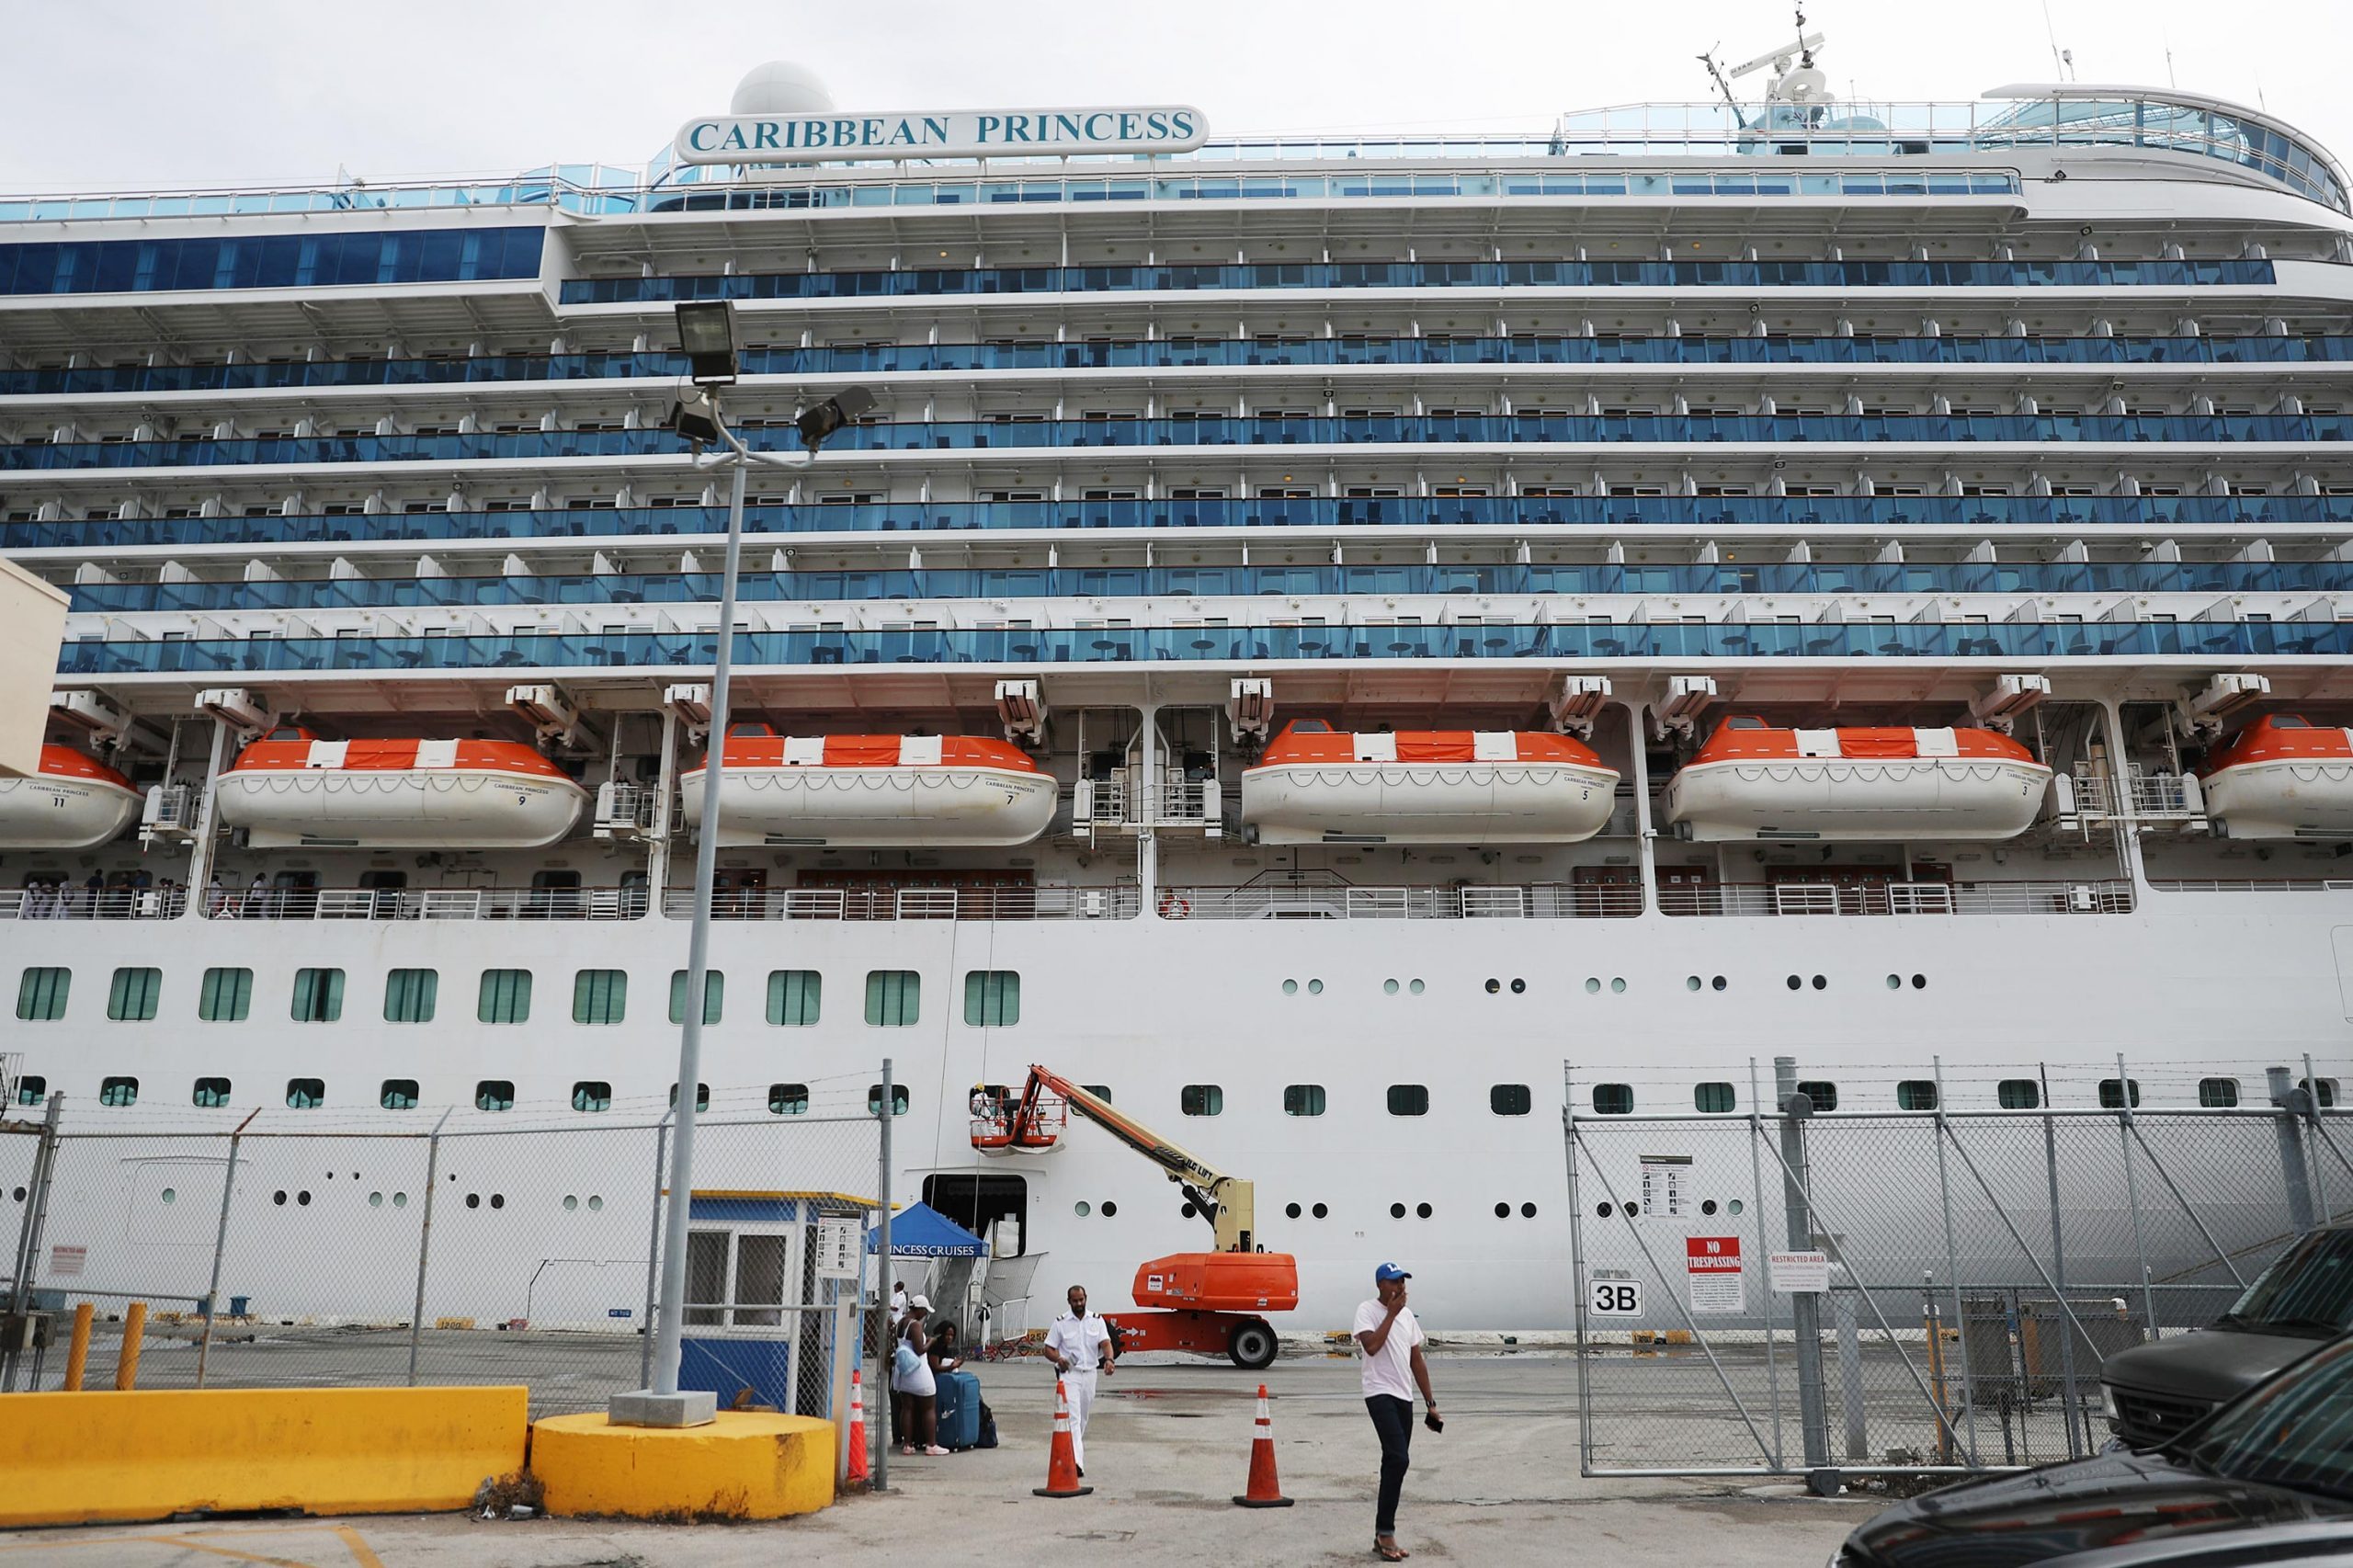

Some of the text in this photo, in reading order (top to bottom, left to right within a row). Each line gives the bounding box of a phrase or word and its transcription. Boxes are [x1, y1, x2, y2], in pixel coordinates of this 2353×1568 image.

[689, 111, 1194, 152] CARIBBEAN PRINCESS
[1582, 790, 1589, 801] 5
[2022, 785, 2028, 796] 3
[53, 797, 65, 808] 11
[518, 796, 526, 806] 9
[1006, 795, 1014, 805] 7
[1186, 1158, 1213, 1181] JLG LIFT
[874, 1244, 974, 1256] INCESS CRUISES
[1706, 1240, 1721, 1254] NO
[1688, 1256, 1741, 1268] TRESPASSING
[1771, 1255, 1809, 1263] RESTRICTED
[1596, 1285, 1636, 1311] 3B
